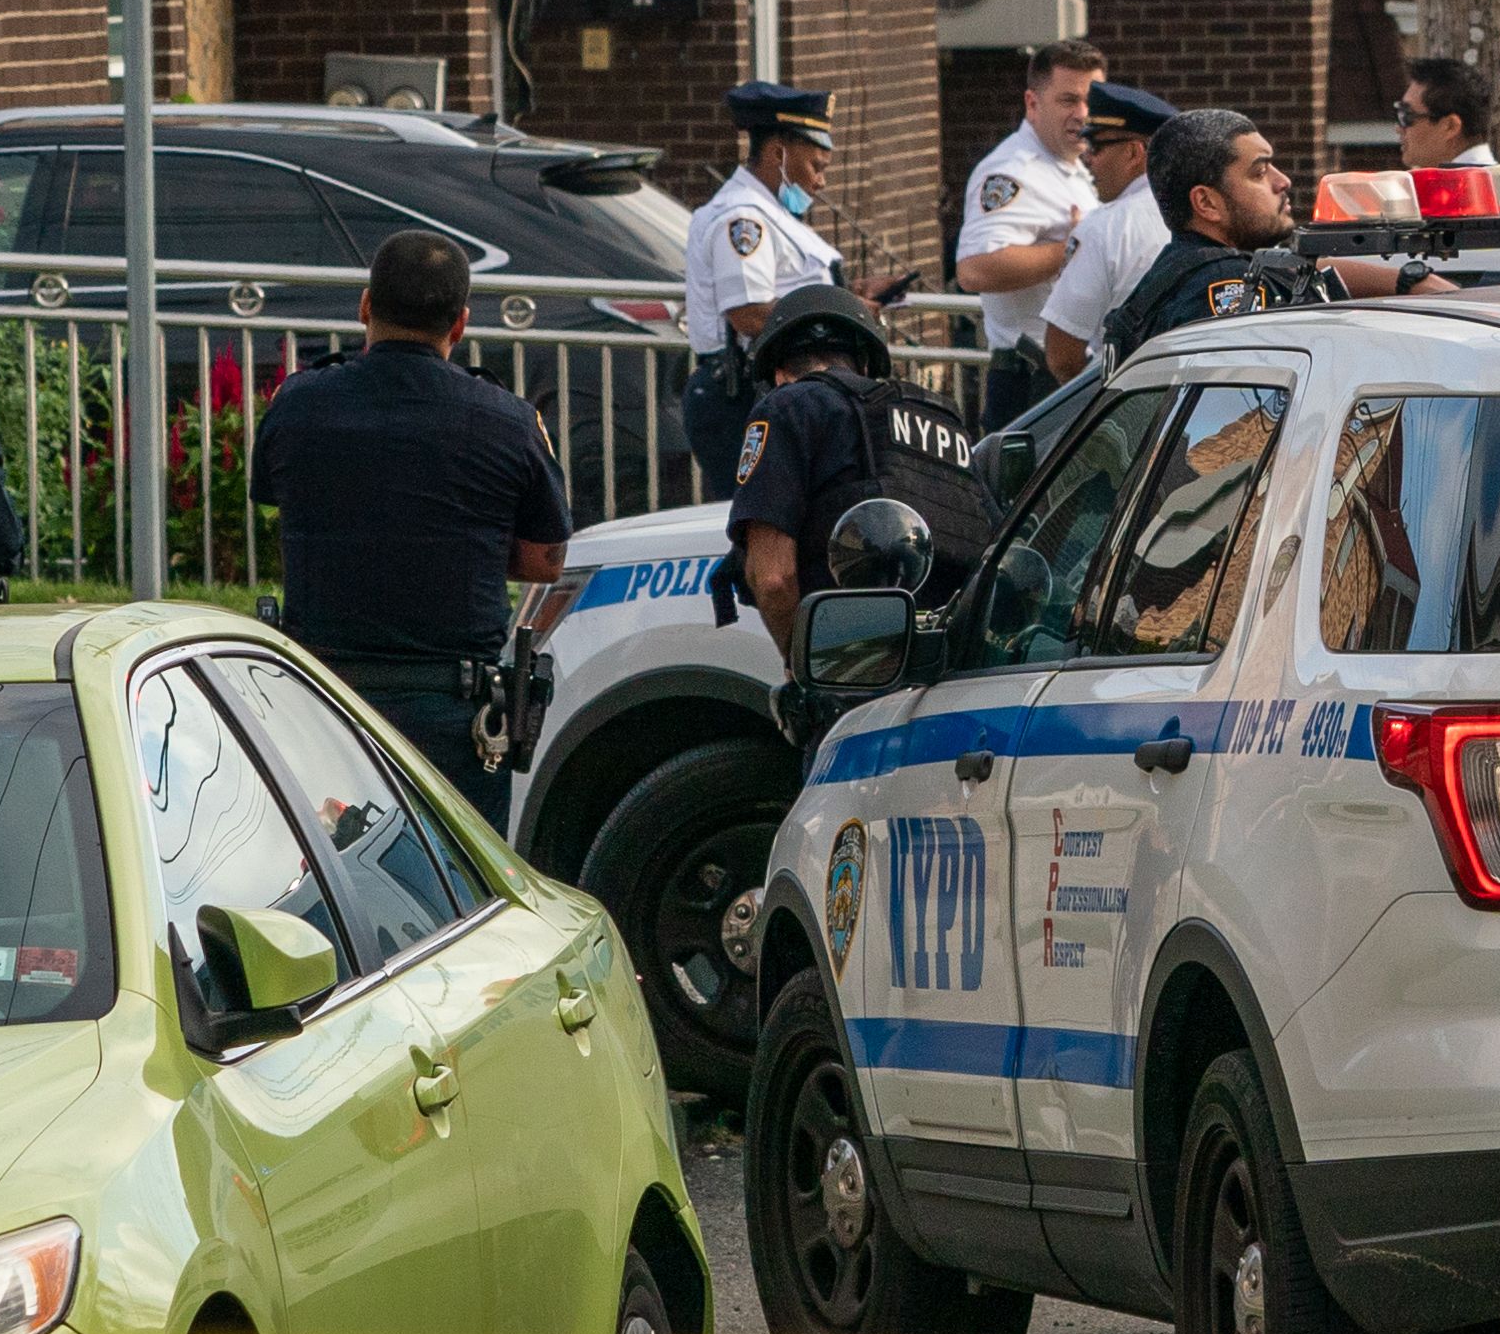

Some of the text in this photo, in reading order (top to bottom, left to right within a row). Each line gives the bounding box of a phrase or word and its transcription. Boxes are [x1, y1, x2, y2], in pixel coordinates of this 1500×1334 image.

[892, 408, 971, 468] NYPD
[1231, 699, 1264, 755] 109
[1257, 698, 1297, 755] PCT
[888, 816, 987, 992] NYPD
